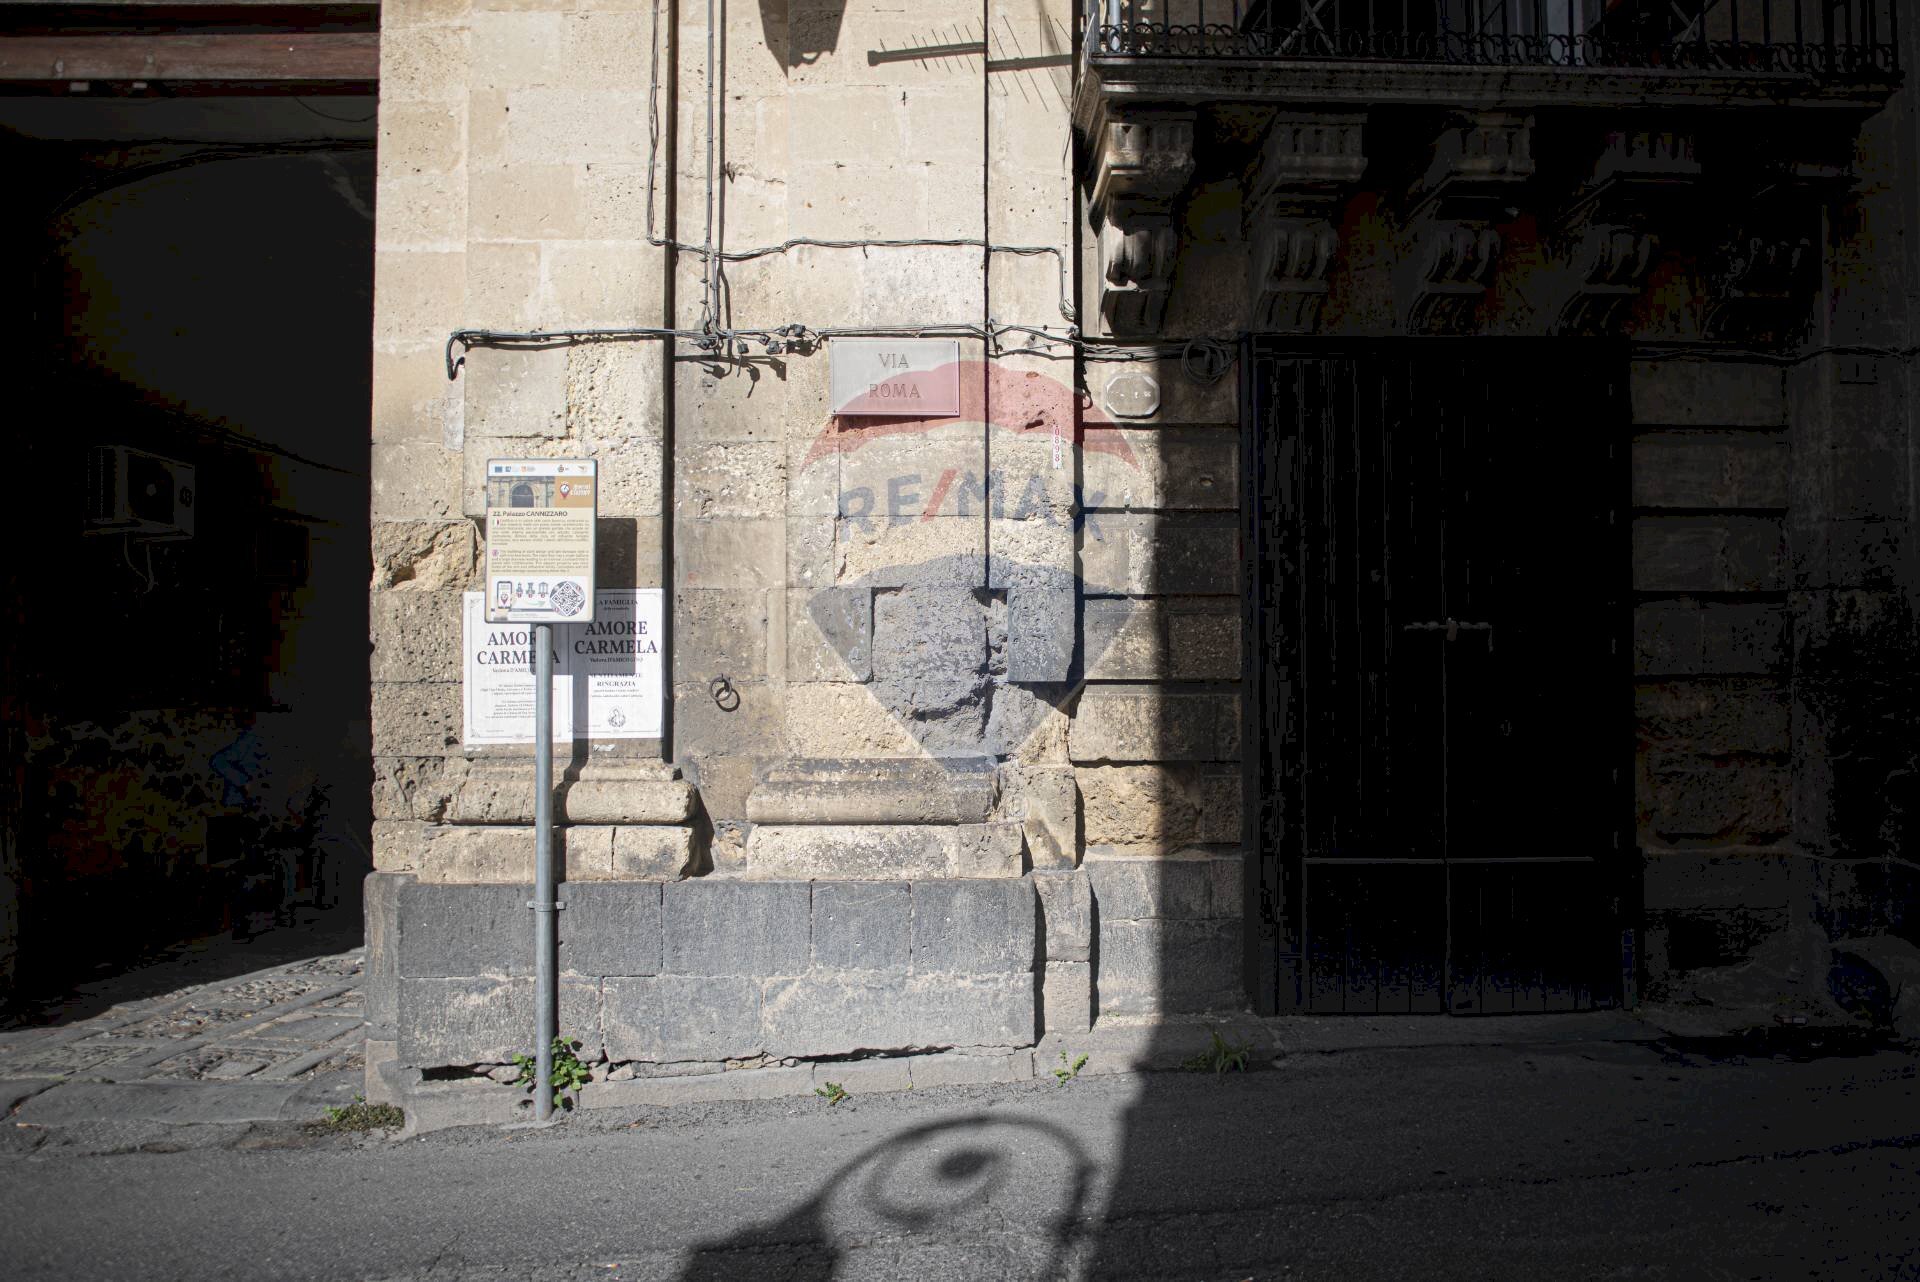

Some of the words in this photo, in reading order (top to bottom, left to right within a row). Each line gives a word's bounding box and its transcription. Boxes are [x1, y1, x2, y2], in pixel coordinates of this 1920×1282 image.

[878, 353, 909, 368] VIA
[869, 383, 920, 398] ROMA
[585, 621, 648, 635] AMORE
[574, 640, 657, 654] CARMELA
[477, 650, 560, 665] CARMEA
